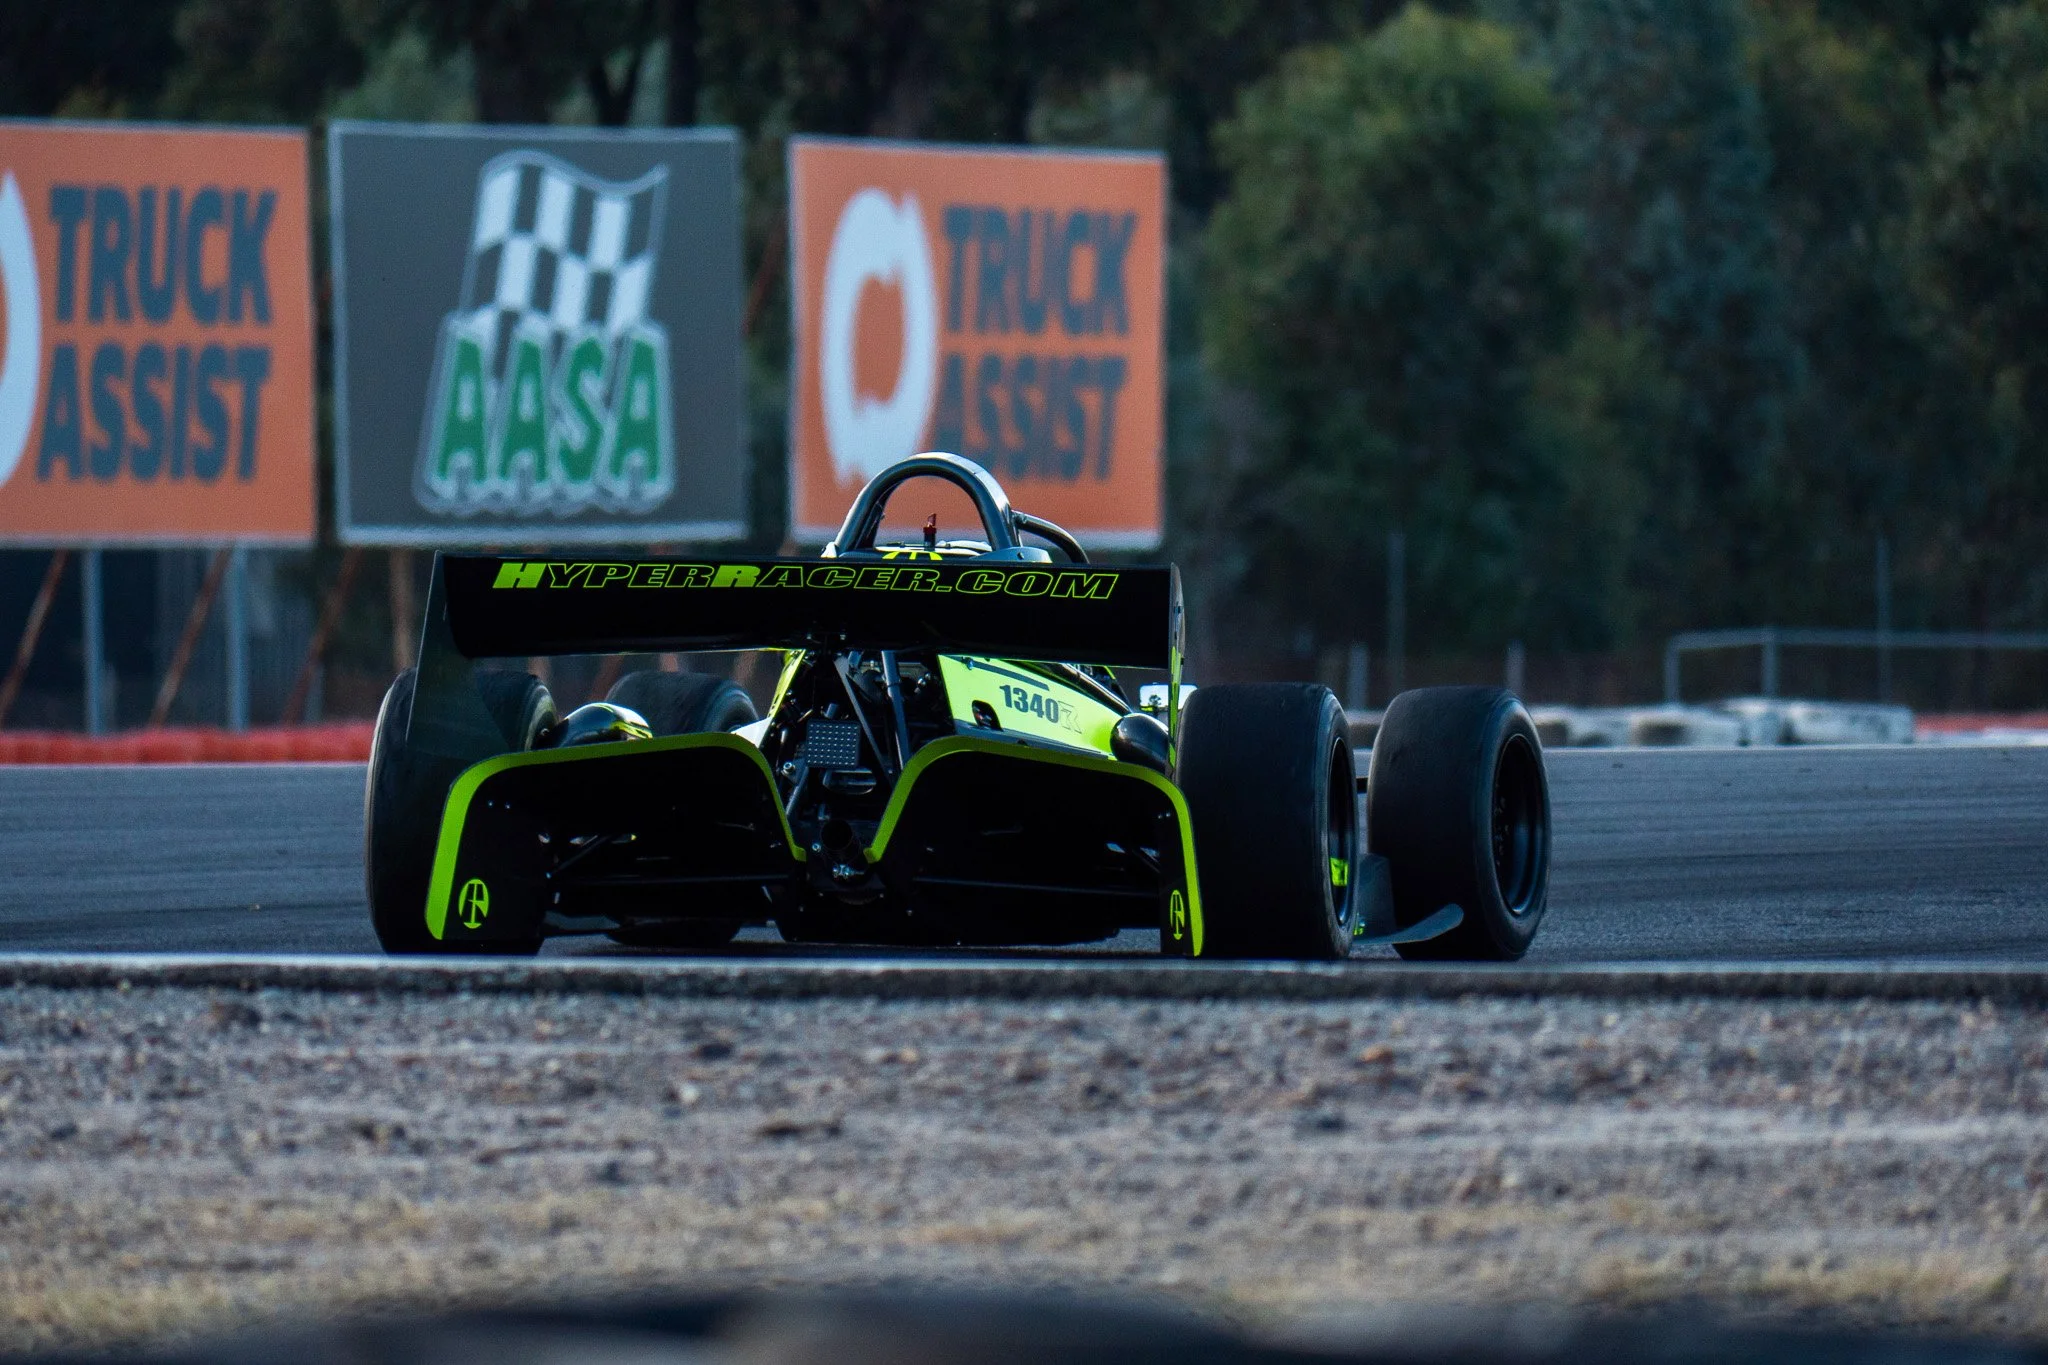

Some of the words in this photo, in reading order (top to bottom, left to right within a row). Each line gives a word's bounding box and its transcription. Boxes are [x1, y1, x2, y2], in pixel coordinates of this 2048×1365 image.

[50, 183, 275, 325] TRUCK
[943, 204, 1138, 336] TRUCK
[37, 341, 271, 484] ASSIST
[428, 327, 668, 496] AASA
[932, 353, 1128, 482] ASSIST
